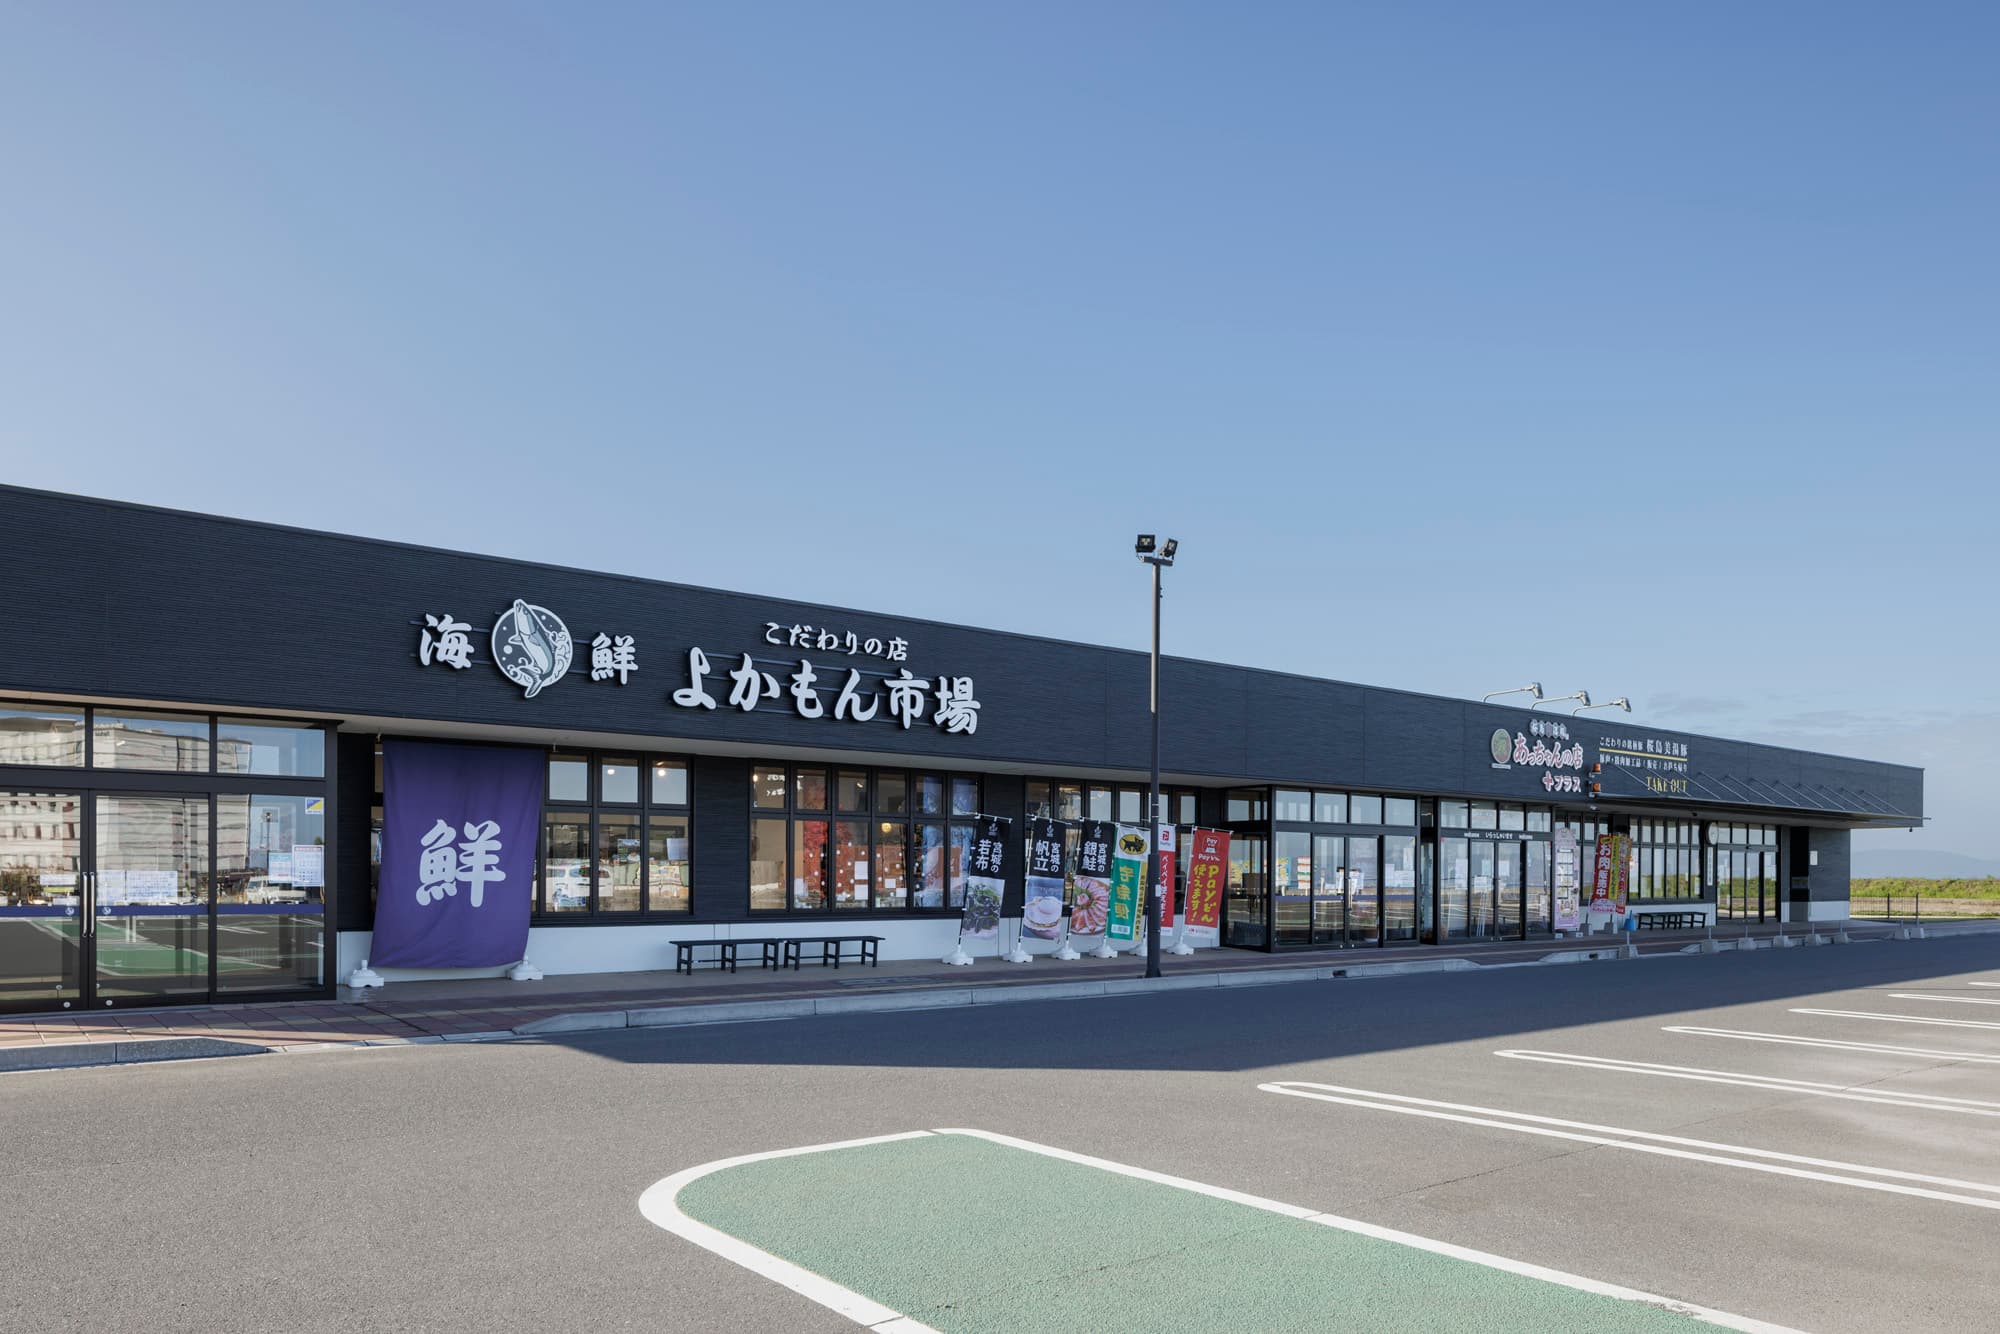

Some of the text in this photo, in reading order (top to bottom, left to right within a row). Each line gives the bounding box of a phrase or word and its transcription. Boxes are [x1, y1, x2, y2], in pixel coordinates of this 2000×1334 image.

[419, 613, 638, 685] 海 鮮
[765, 622, 909, 662] こだわりの店
[672, 647, 981, 735] よかもん市場
[1513, 731, 1584, 770] あっちゃんの店
[1646, 776, 1687, 793] TAKE OUT
[415, 818, 507, 909] 鮮
[975, 839, 992, 871] 若布
[990, 841, 1003, 873] 宮城の
[1033, 839, 1050, 872] 帆立
[1050, 842, 1061, 873] 宮城の
[1082, 840, 1098, 871] 銀鮭
[1097, 842, 1108, 873] 宮城の
[1201, 864, 1220, 923] Payどん
